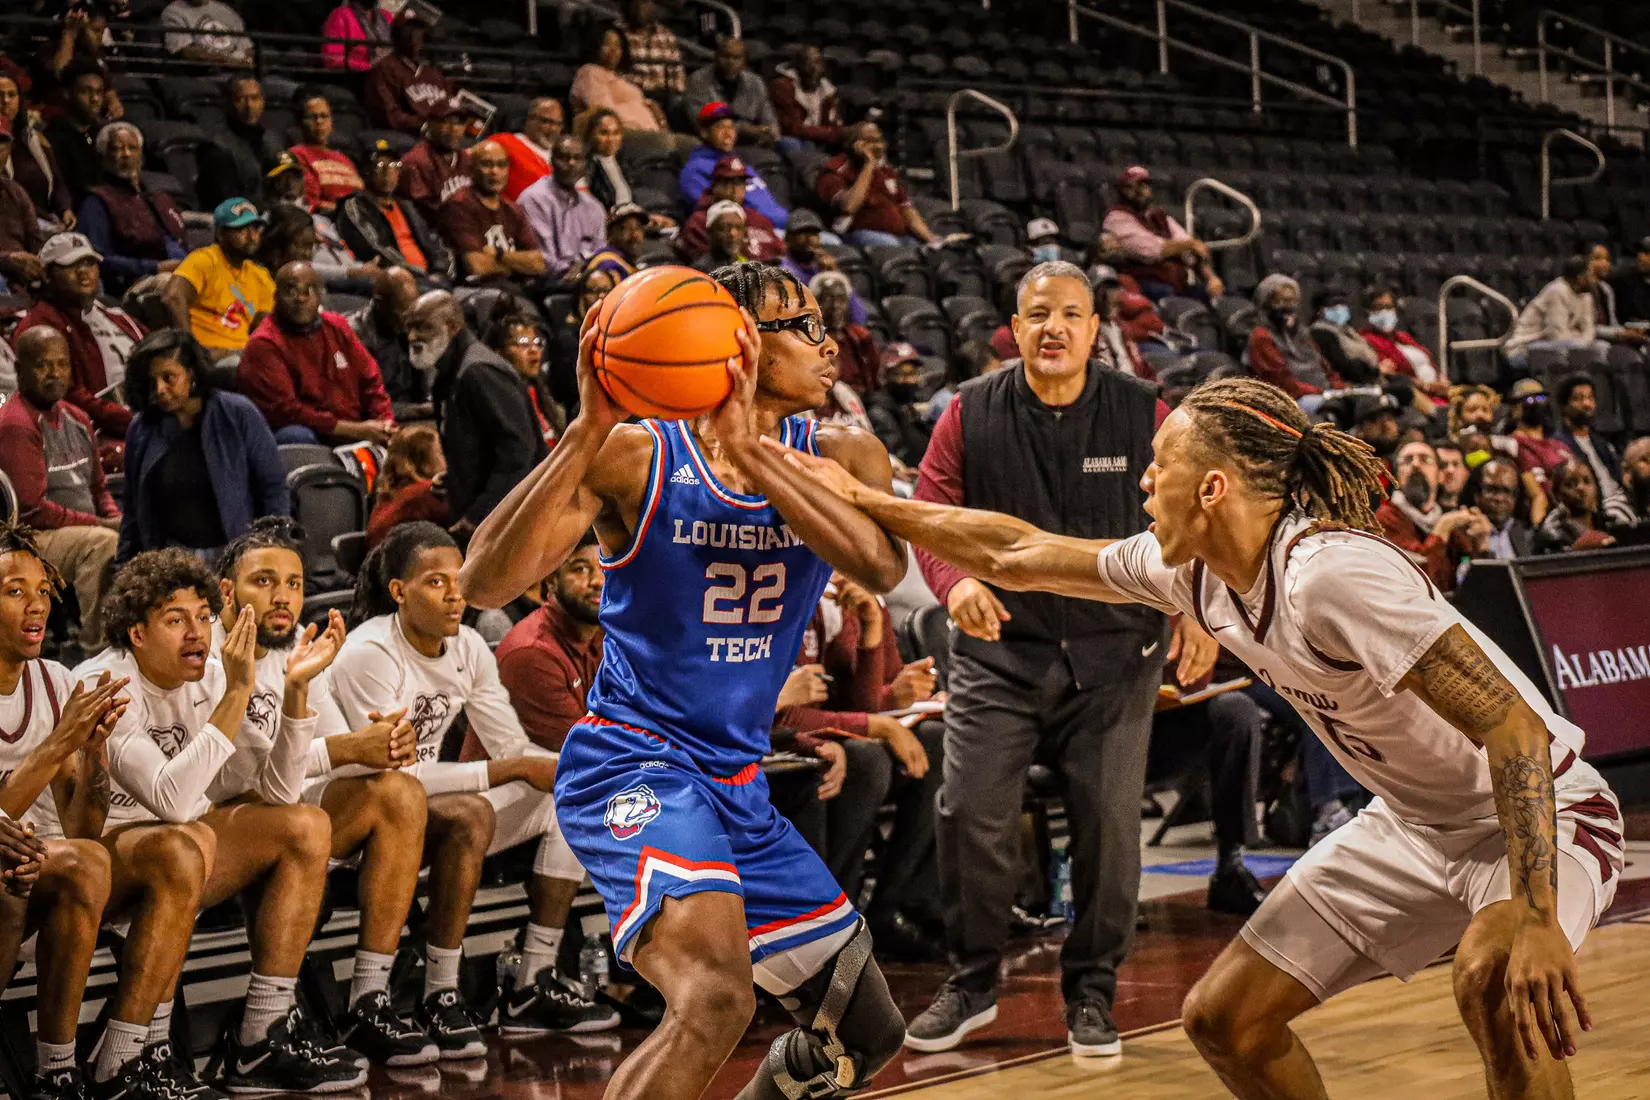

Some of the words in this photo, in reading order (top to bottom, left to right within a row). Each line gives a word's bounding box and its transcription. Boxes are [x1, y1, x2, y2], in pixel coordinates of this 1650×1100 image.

[670, 475, 700, 485] adidas
[673, 519, 804, 550] LOUISIAN
[702, 562, 786, 625] 22
[706, 634, 773, 663] TECH
[1552, 643, 1650, 690] ALABAM
